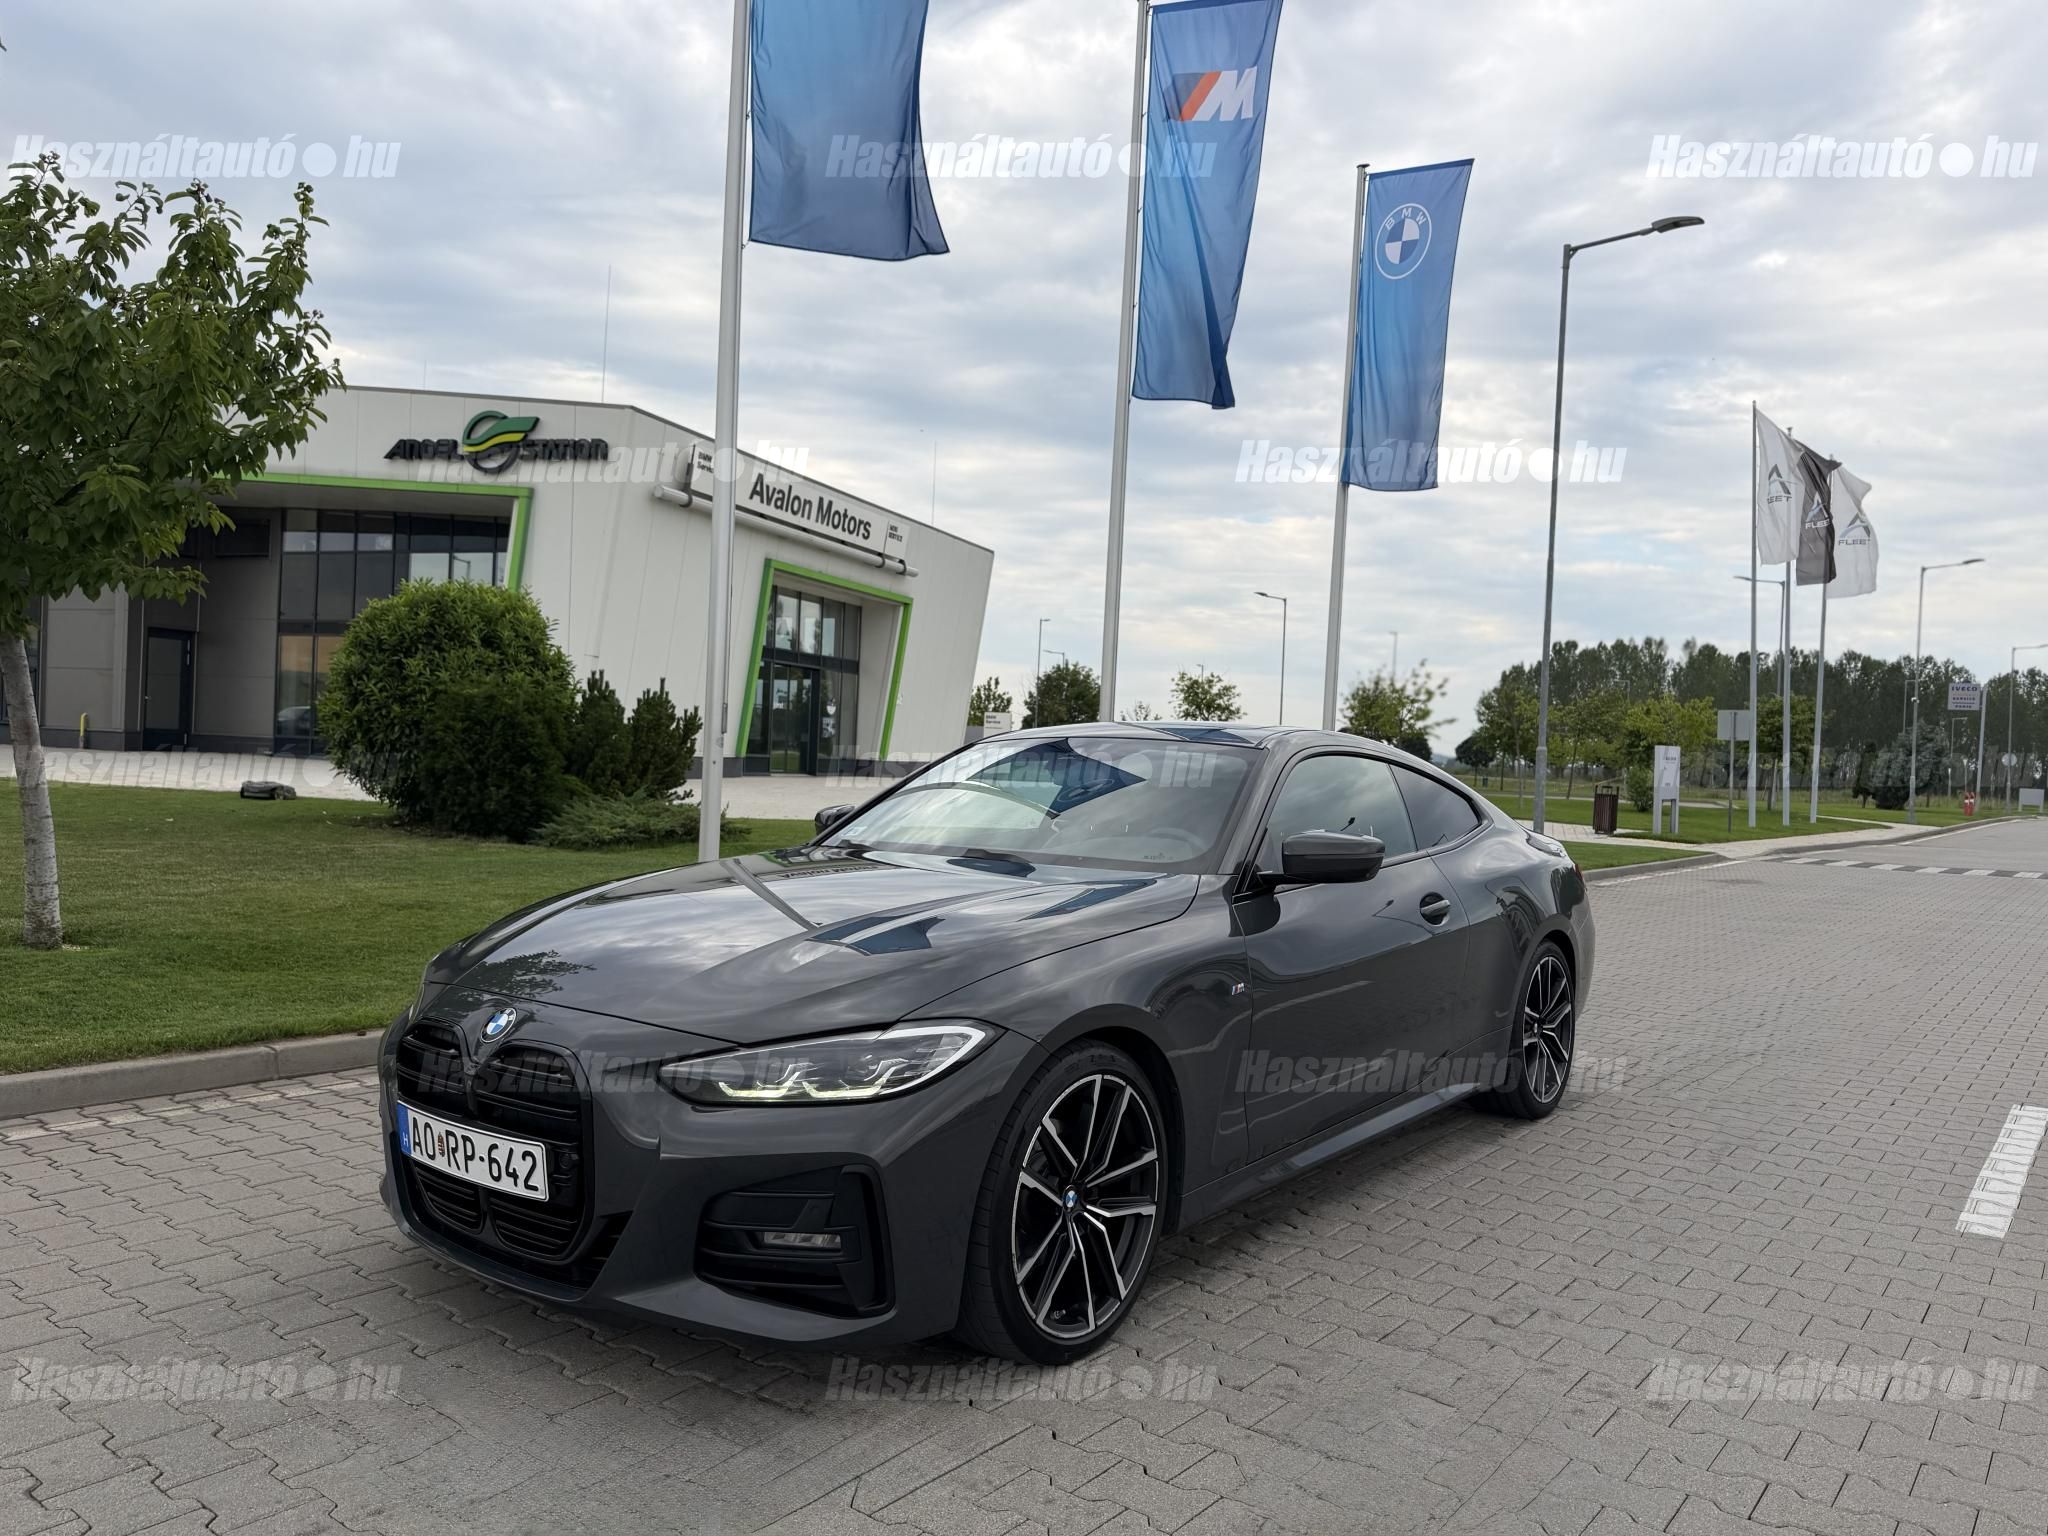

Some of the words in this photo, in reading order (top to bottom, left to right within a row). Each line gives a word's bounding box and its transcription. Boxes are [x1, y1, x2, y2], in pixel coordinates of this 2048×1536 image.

[1385, 207, 1427, 230] BMW
[749, 472, 813, 521] Avalon
[815, 495, 872, 540] Motors
